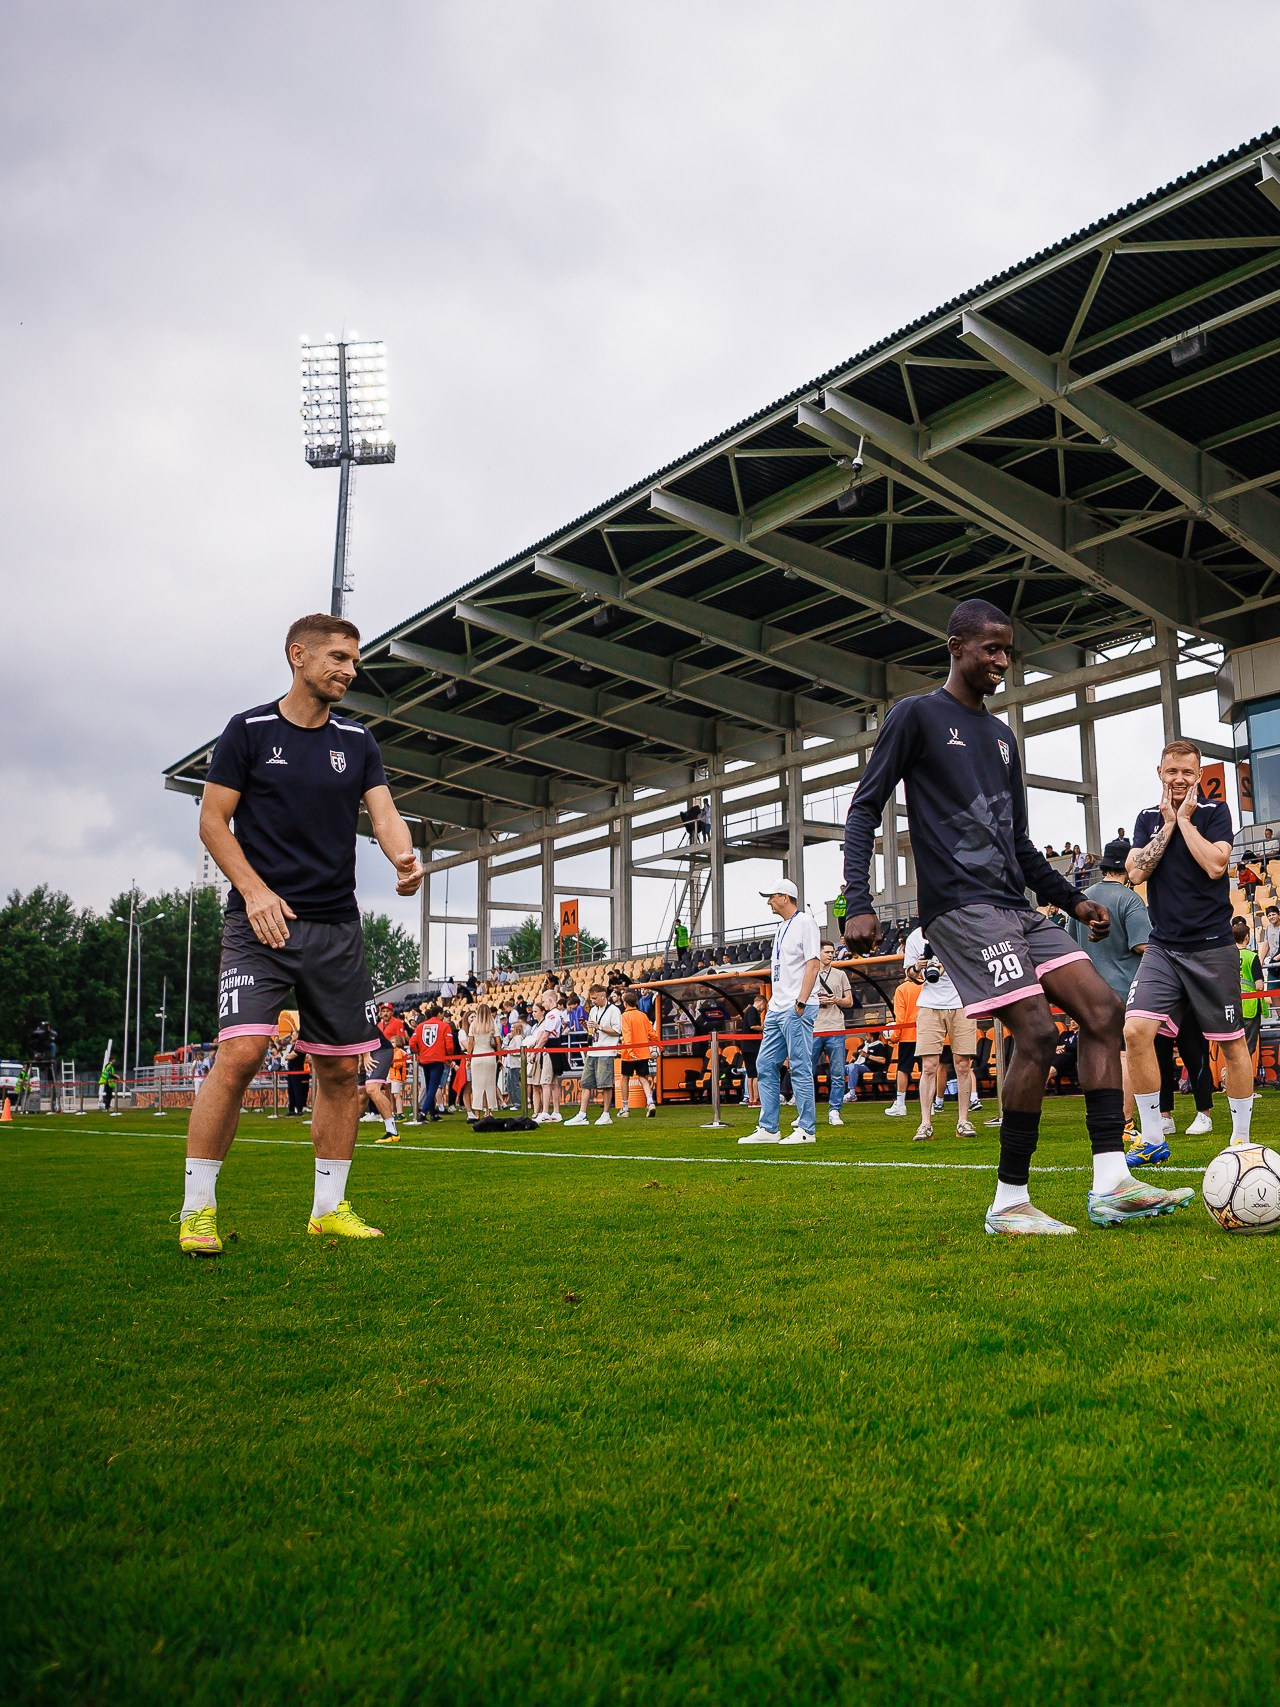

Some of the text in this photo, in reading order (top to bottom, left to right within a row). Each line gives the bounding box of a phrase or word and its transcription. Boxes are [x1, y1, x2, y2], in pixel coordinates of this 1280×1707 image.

[562, 909, 576, 926] A1
[981, 940, 1015, 961] BALDE
[987, 953, 1024, 988] 29
[219, 988, 239, 1018] 21
[365, 1004, 377, 1025] FC
